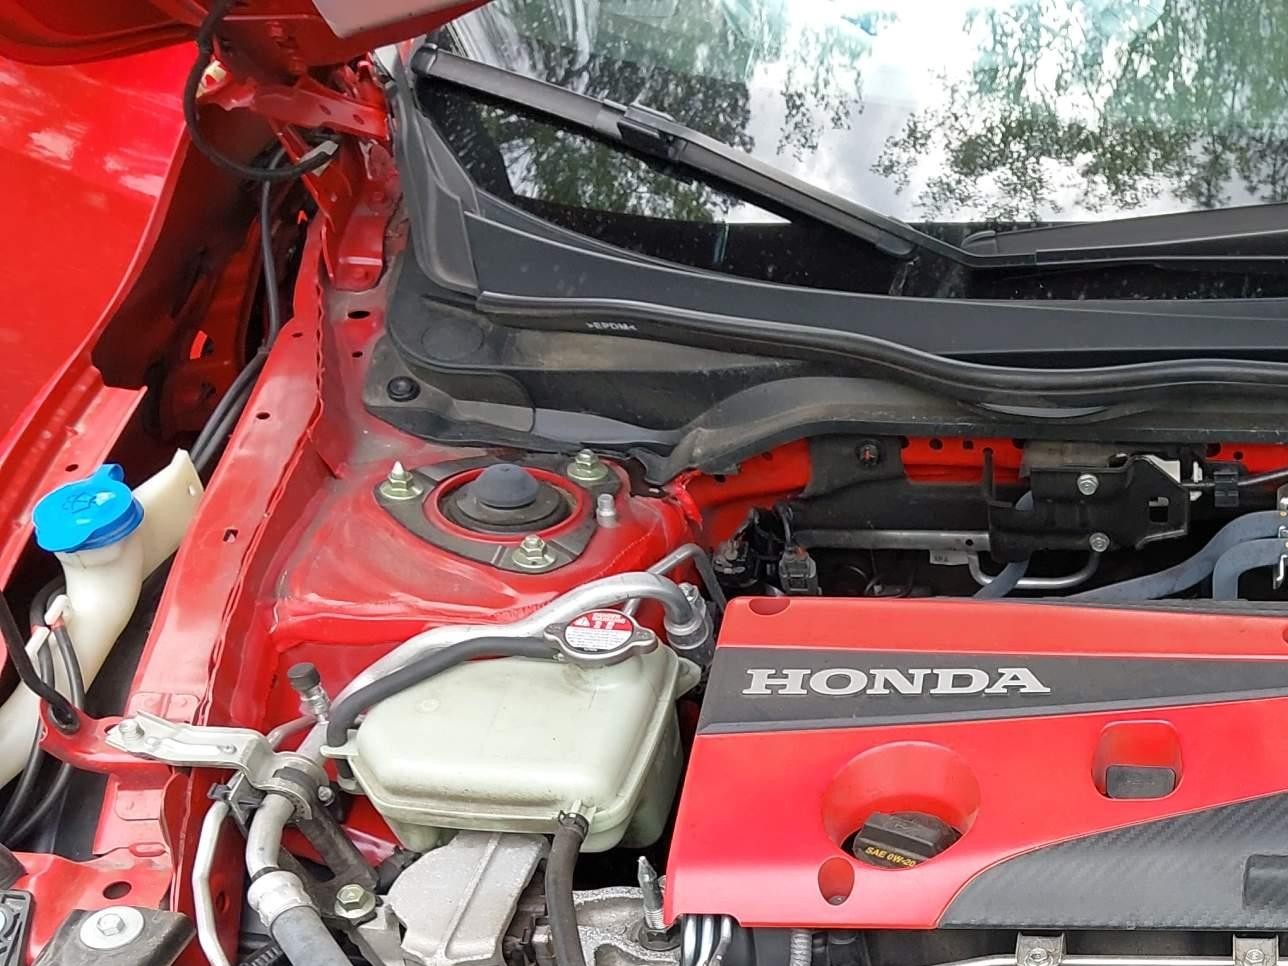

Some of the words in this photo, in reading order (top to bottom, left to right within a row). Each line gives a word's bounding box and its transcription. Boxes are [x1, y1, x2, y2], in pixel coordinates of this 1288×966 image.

[742, 668, 1051, 695] HONDA
[865, 847, 887, 858] SAE
[887, 853, 916, 867] 0W-20
